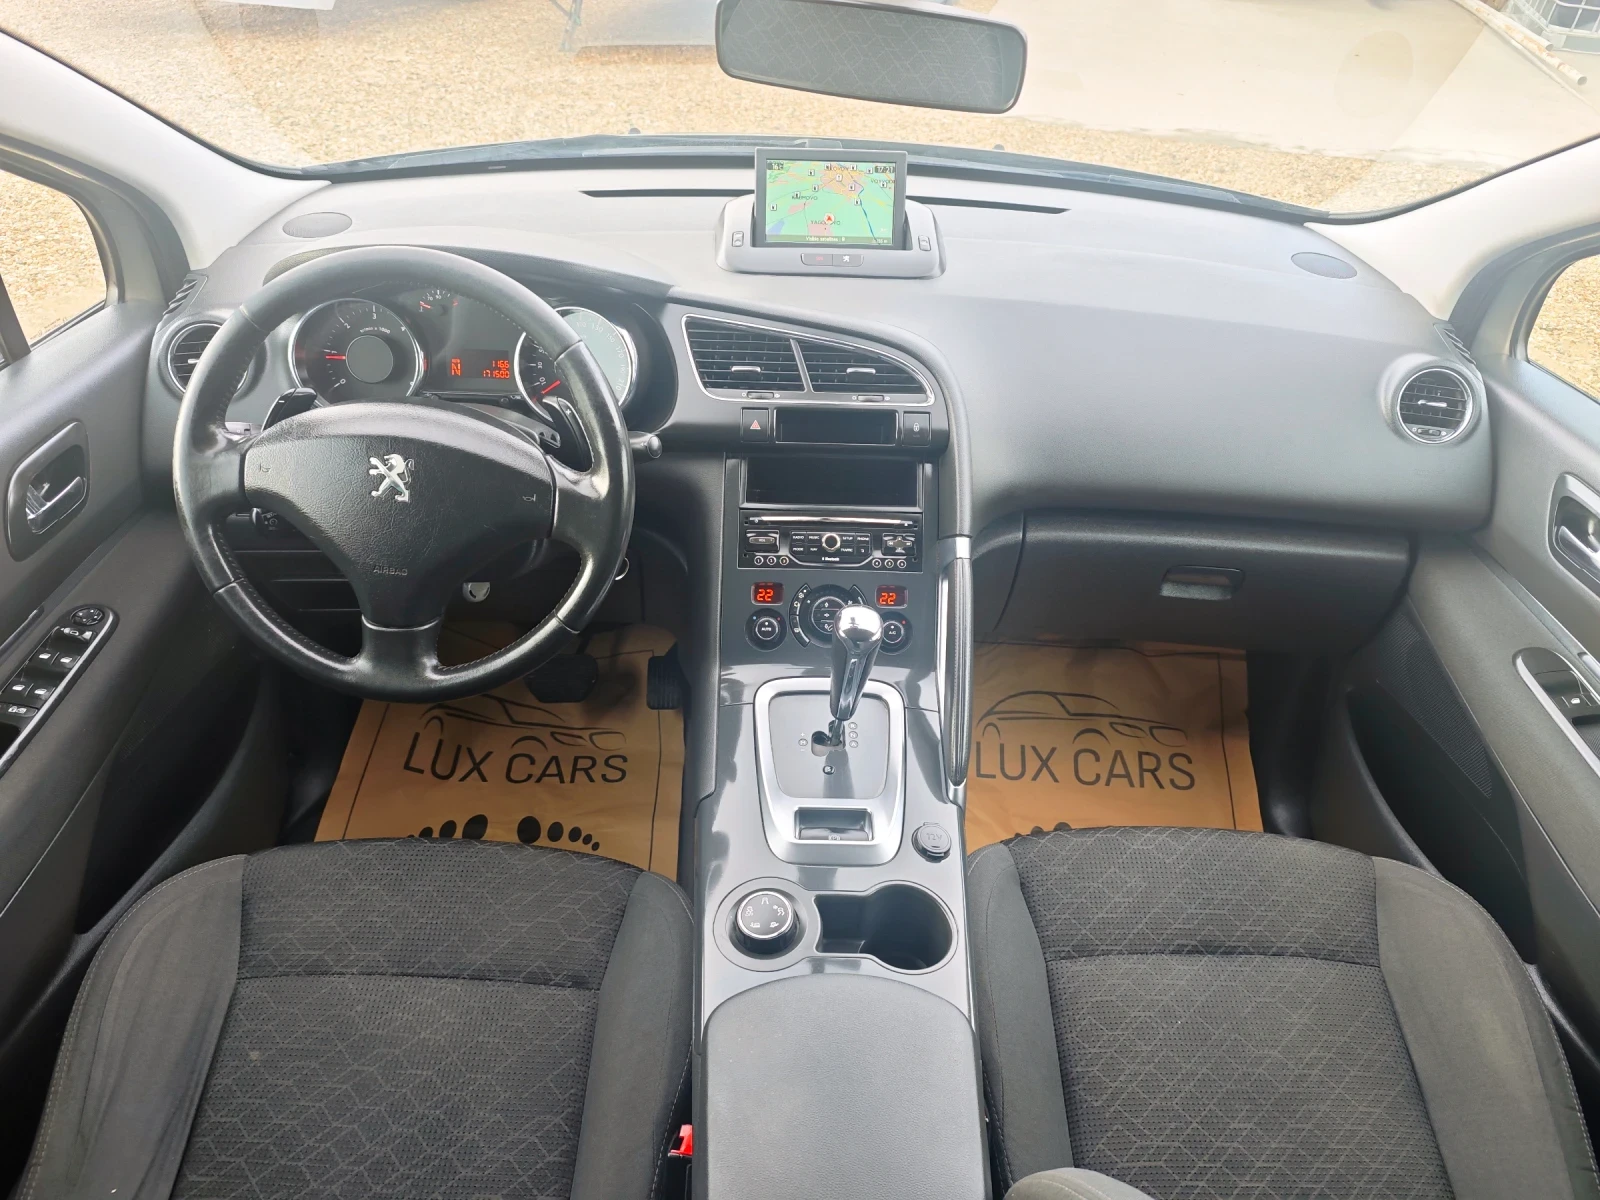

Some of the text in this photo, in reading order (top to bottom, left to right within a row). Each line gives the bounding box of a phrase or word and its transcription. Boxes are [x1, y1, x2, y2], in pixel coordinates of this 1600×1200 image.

[371, 312, 377, 320] 3
[756, 588, 774, 601] 22
[879, 591, 897, 605] 22
[403, 731, 629, 784] LUX CARS
[975, 740, 1196, 791] LUX CARS
